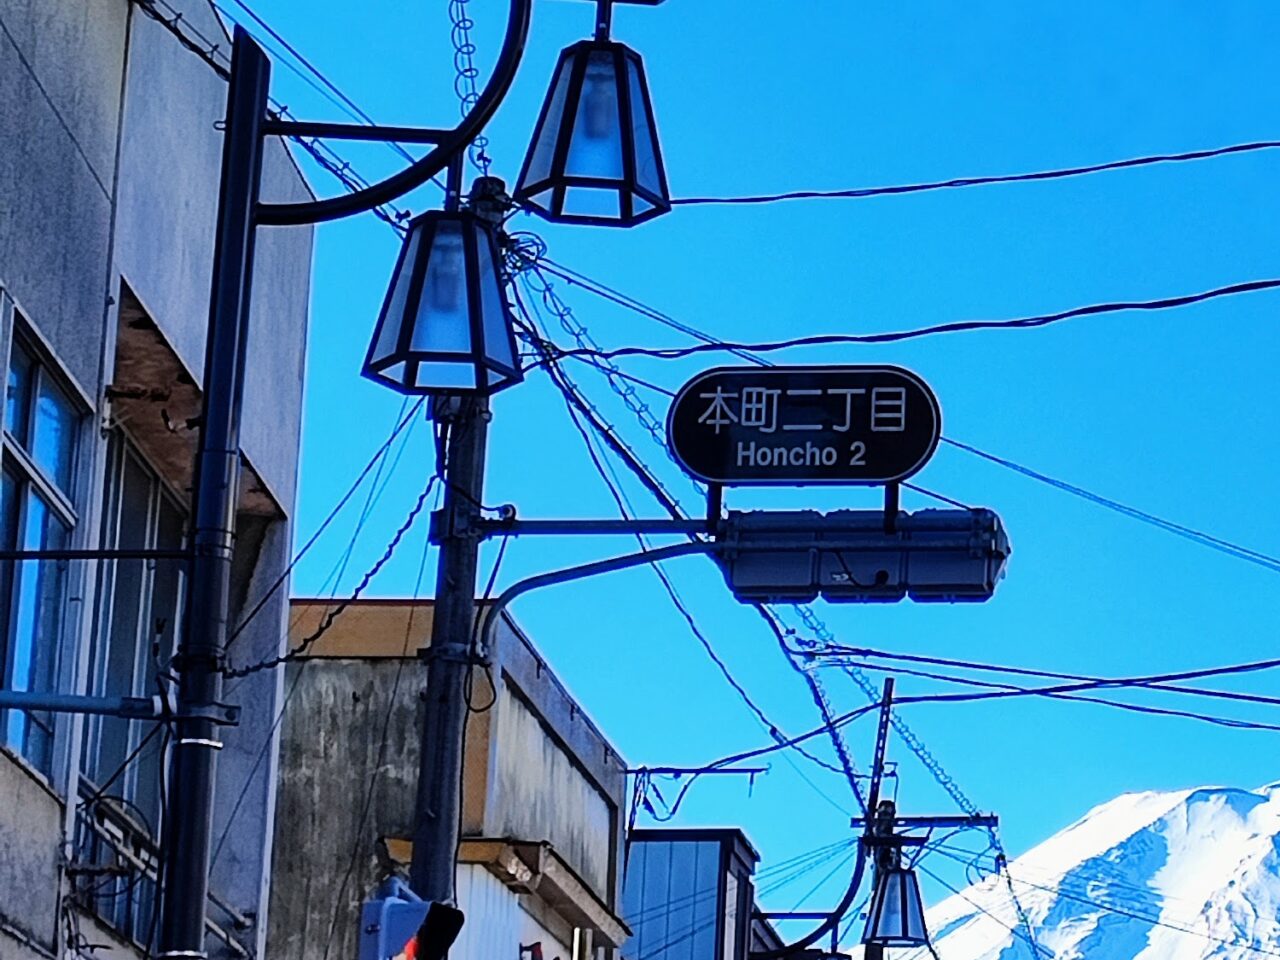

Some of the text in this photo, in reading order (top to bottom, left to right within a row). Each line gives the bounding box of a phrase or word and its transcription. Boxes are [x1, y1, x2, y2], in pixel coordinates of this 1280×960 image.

[698, 386, 906, 434] 本町二丁目
[737, 441, 866, 466] Honcho 2
